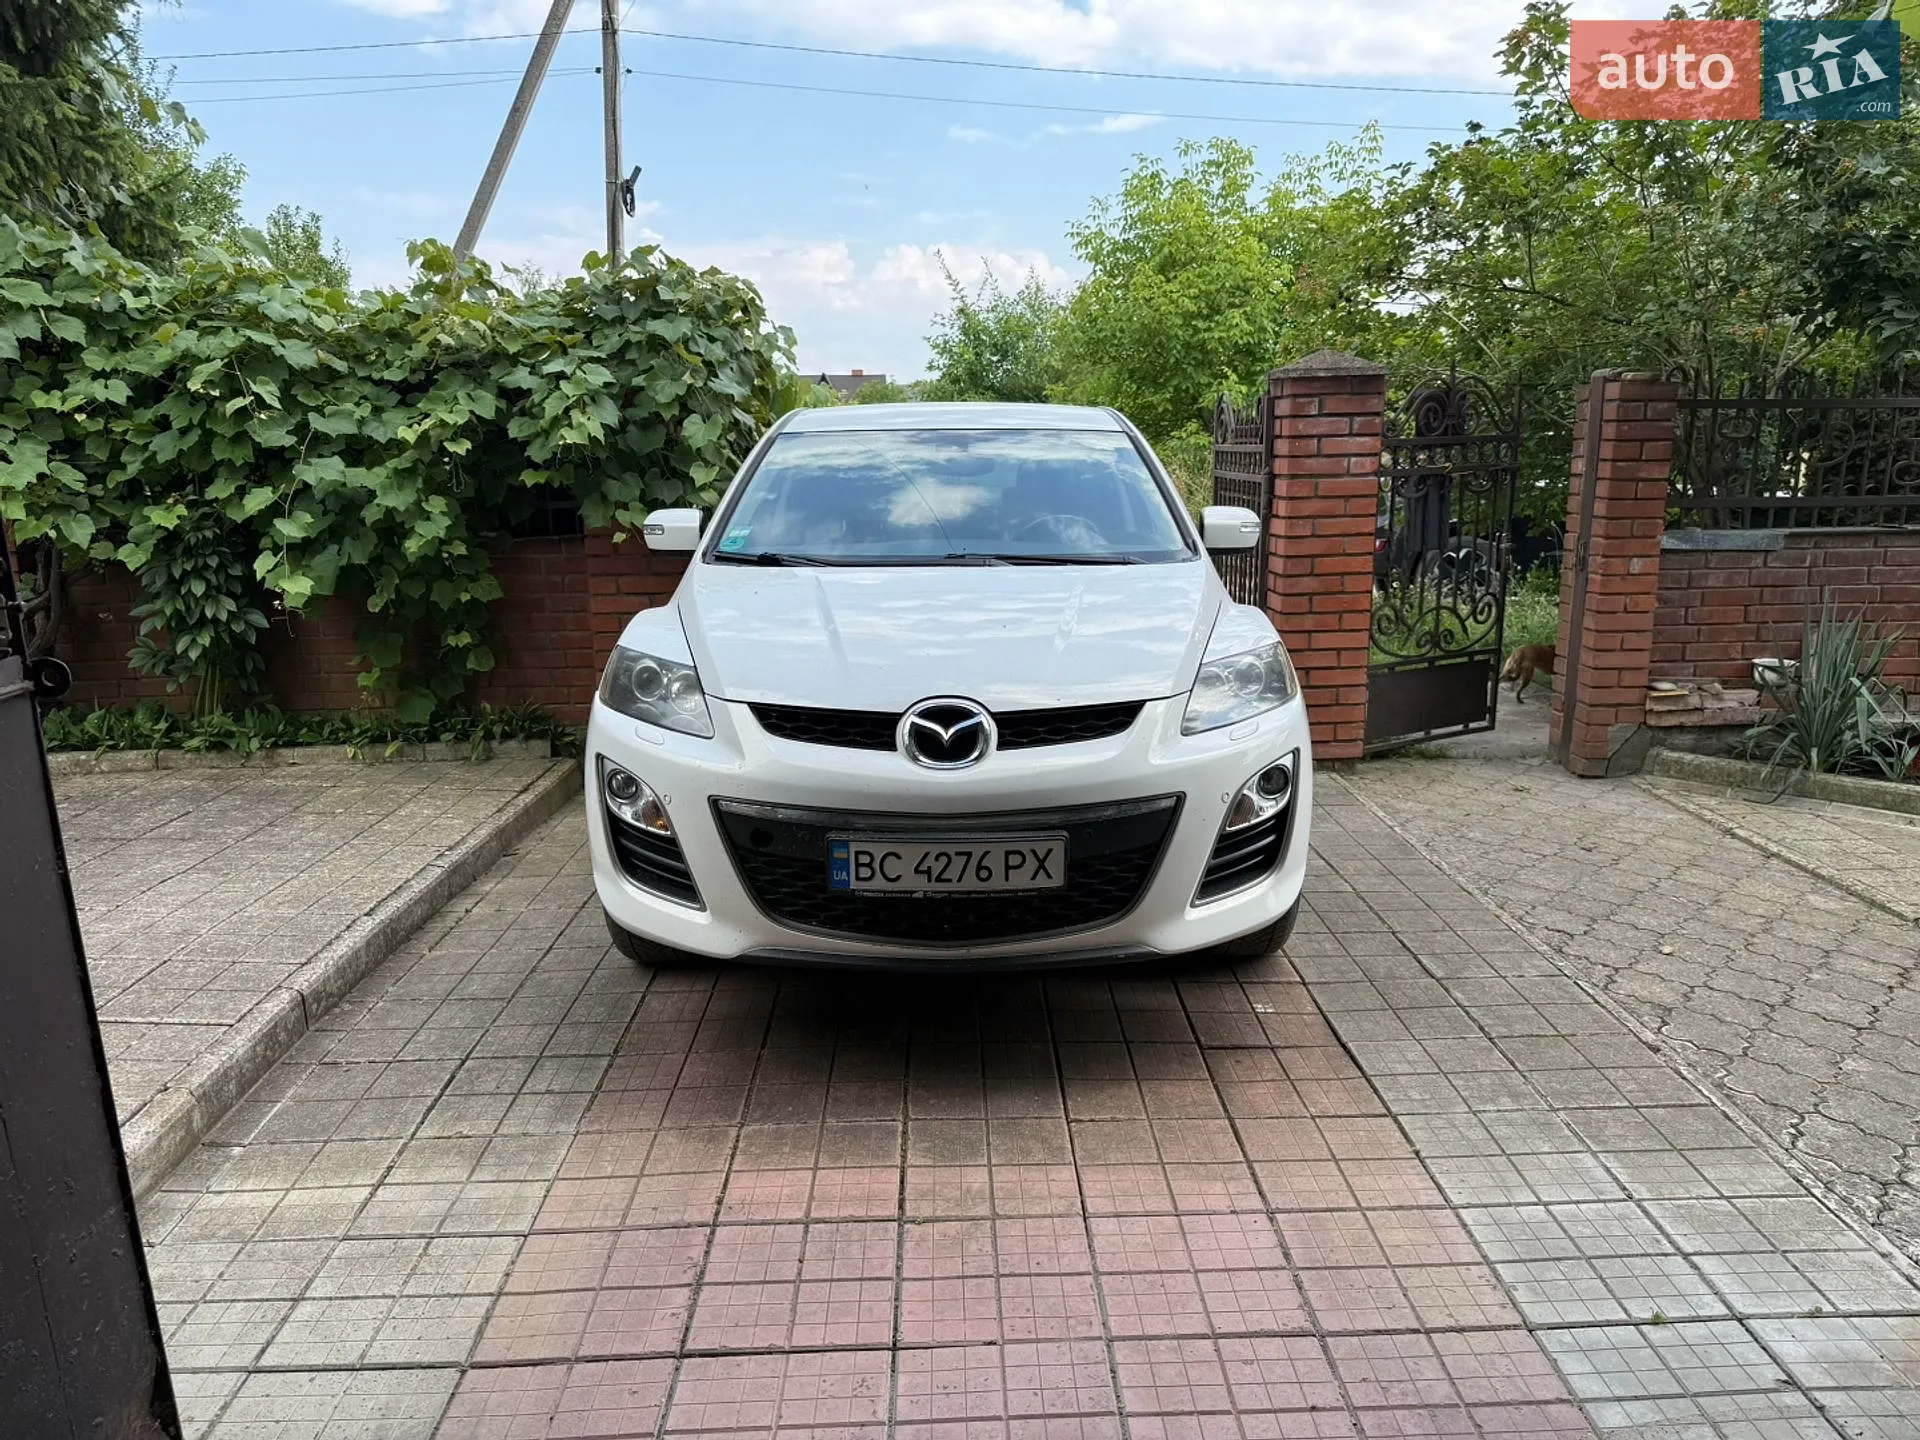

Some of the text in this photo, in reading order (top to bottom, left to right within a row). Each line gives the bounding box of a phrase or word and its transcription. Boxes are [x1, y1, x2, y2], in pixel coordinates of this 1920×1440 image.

[832, 870, 848, 881] UA
[854, 848, 1054, 884] BC 4276 PX
